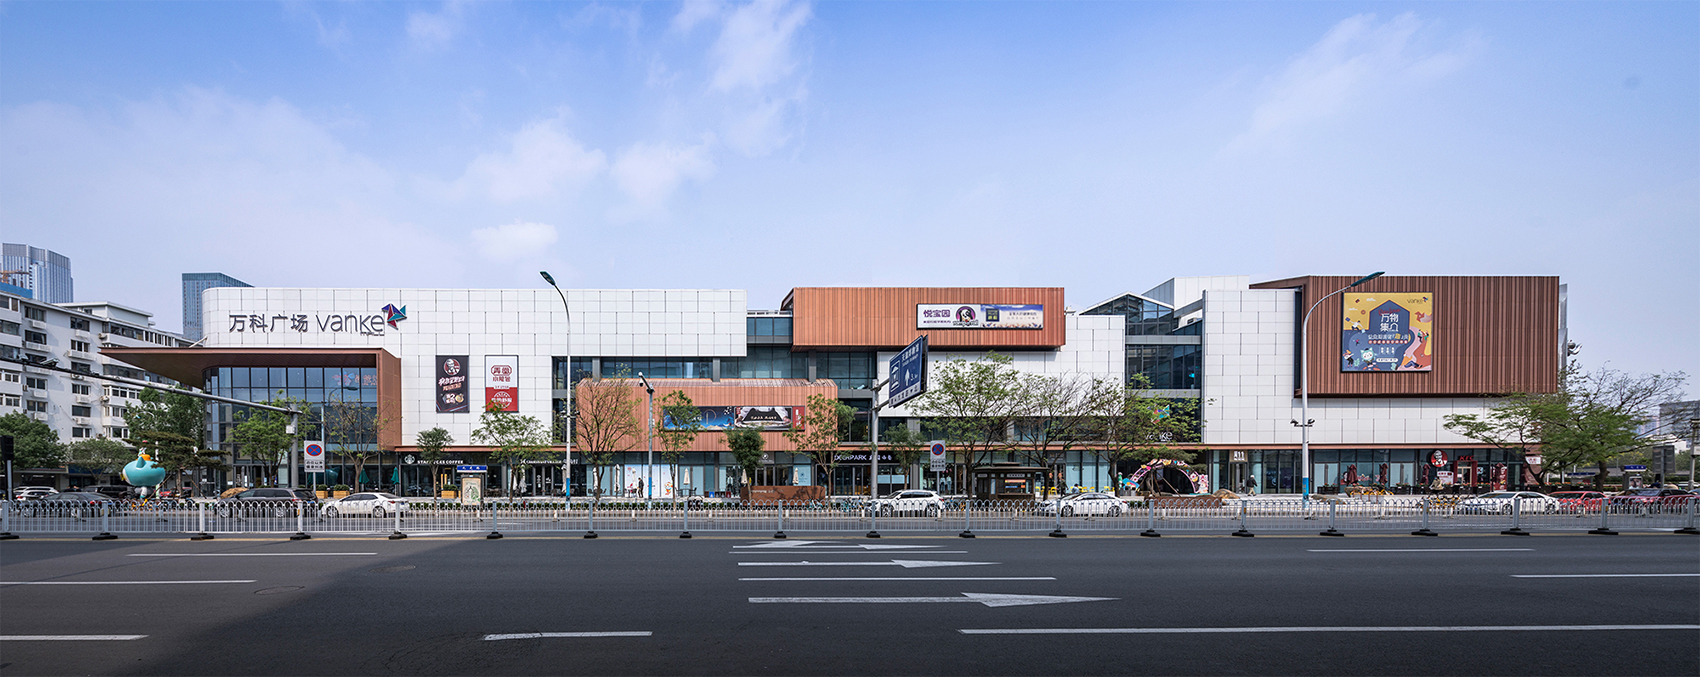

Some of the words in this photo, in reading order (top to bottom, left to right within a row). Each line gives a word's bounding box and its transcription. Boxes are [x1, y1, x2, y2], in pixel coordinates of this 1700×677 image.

[923, 309, 951, 318] 悦宝园
[1380, 313, 1399, 323] 万物
[228, 313, 309, 333] 万科广场
[315, 314, 386, 333] vanke
